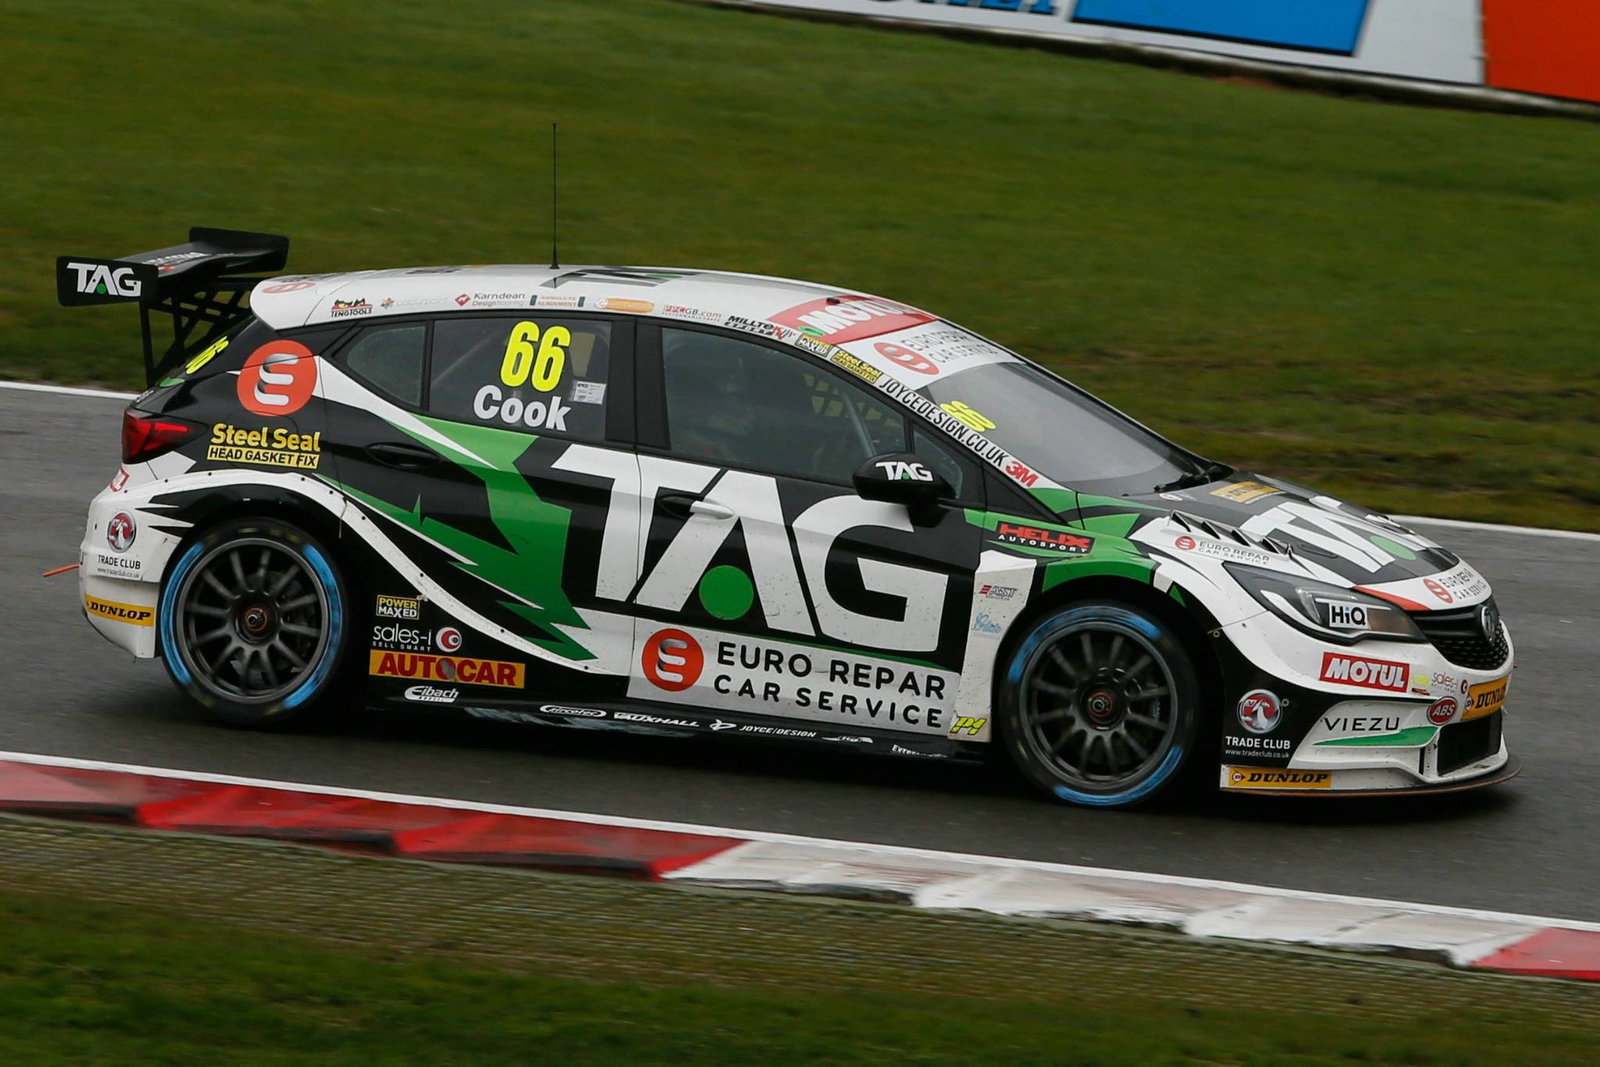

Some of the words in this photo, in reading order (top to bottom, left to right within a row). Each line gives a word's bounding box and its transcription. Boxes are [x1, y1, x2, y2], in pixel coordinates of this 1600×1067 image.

[66, 262, 142, 297] TAG
[474, 292, 526, 300] Karndean
[500, 320, 572, 393] 66
[836, 349, 861, 367] Steel
[860, 362, 882, 379] Seal
[473, 384, 571, 432] Cook
[879, 378, 1008, 468] JOYCEDESIGN.CO.UK
[210, 422, 269, 448] Steel
[271, 428, 321, 452] Seal
[209, 447, 242, 461] HEAD
[244, 450, 295, 465] GASKET
[296, 453, 316, 467] FIX
[875, 461, 934, 482] TAG
[1005, 460, 1039, 487] 3M
[997, 534, 1088, 554] AUTOSPORT
[998, 523, 1092, 549] HELIX
[551, 443, 949, 652] TAG
[1199, 541, 1230, 554] EURO
[1233, 547, 1271, 563] REPAR
[98, 554, 119, 567] TRADE
[119, 557, 141, 570] CLUB
[90, 601, 151, 621] DUNLOP
[378, 606, 417, 619] MAXED
[379, 597, 417, 609] POWER
[1331, 605, 1367, 627] HiQ
[372, 641, 395, 649] SELL
[400, 643, 432, 652] SMART
[376, 652, 517, 686] AUTOCAR
[717, 641, 812, 677] EURO
[829, 659, 946, 700] REPAR
[1324, 658, 1407, 690] MOTUL
[404, 685, 460, 703] Eibach
[714, 674, 780, 702] CAR
[796, 687, 942, 728] SERVICE
[613, 711, 700, 728] VAUXHALL
[1432, 704, 1456, 717] ABS
[739, 724, 817, 738] JOYCE/DESIGN
[1324, 717, 1401, 732] VIEZU
[1225, 735, 1261, 748] TRADE
[1263, 738, 1291, 750] CLUB
[1225, 749, 1290, 759] www.tradeclub.co.uk
[1247, 771, 1329, 784] DUNLOP
